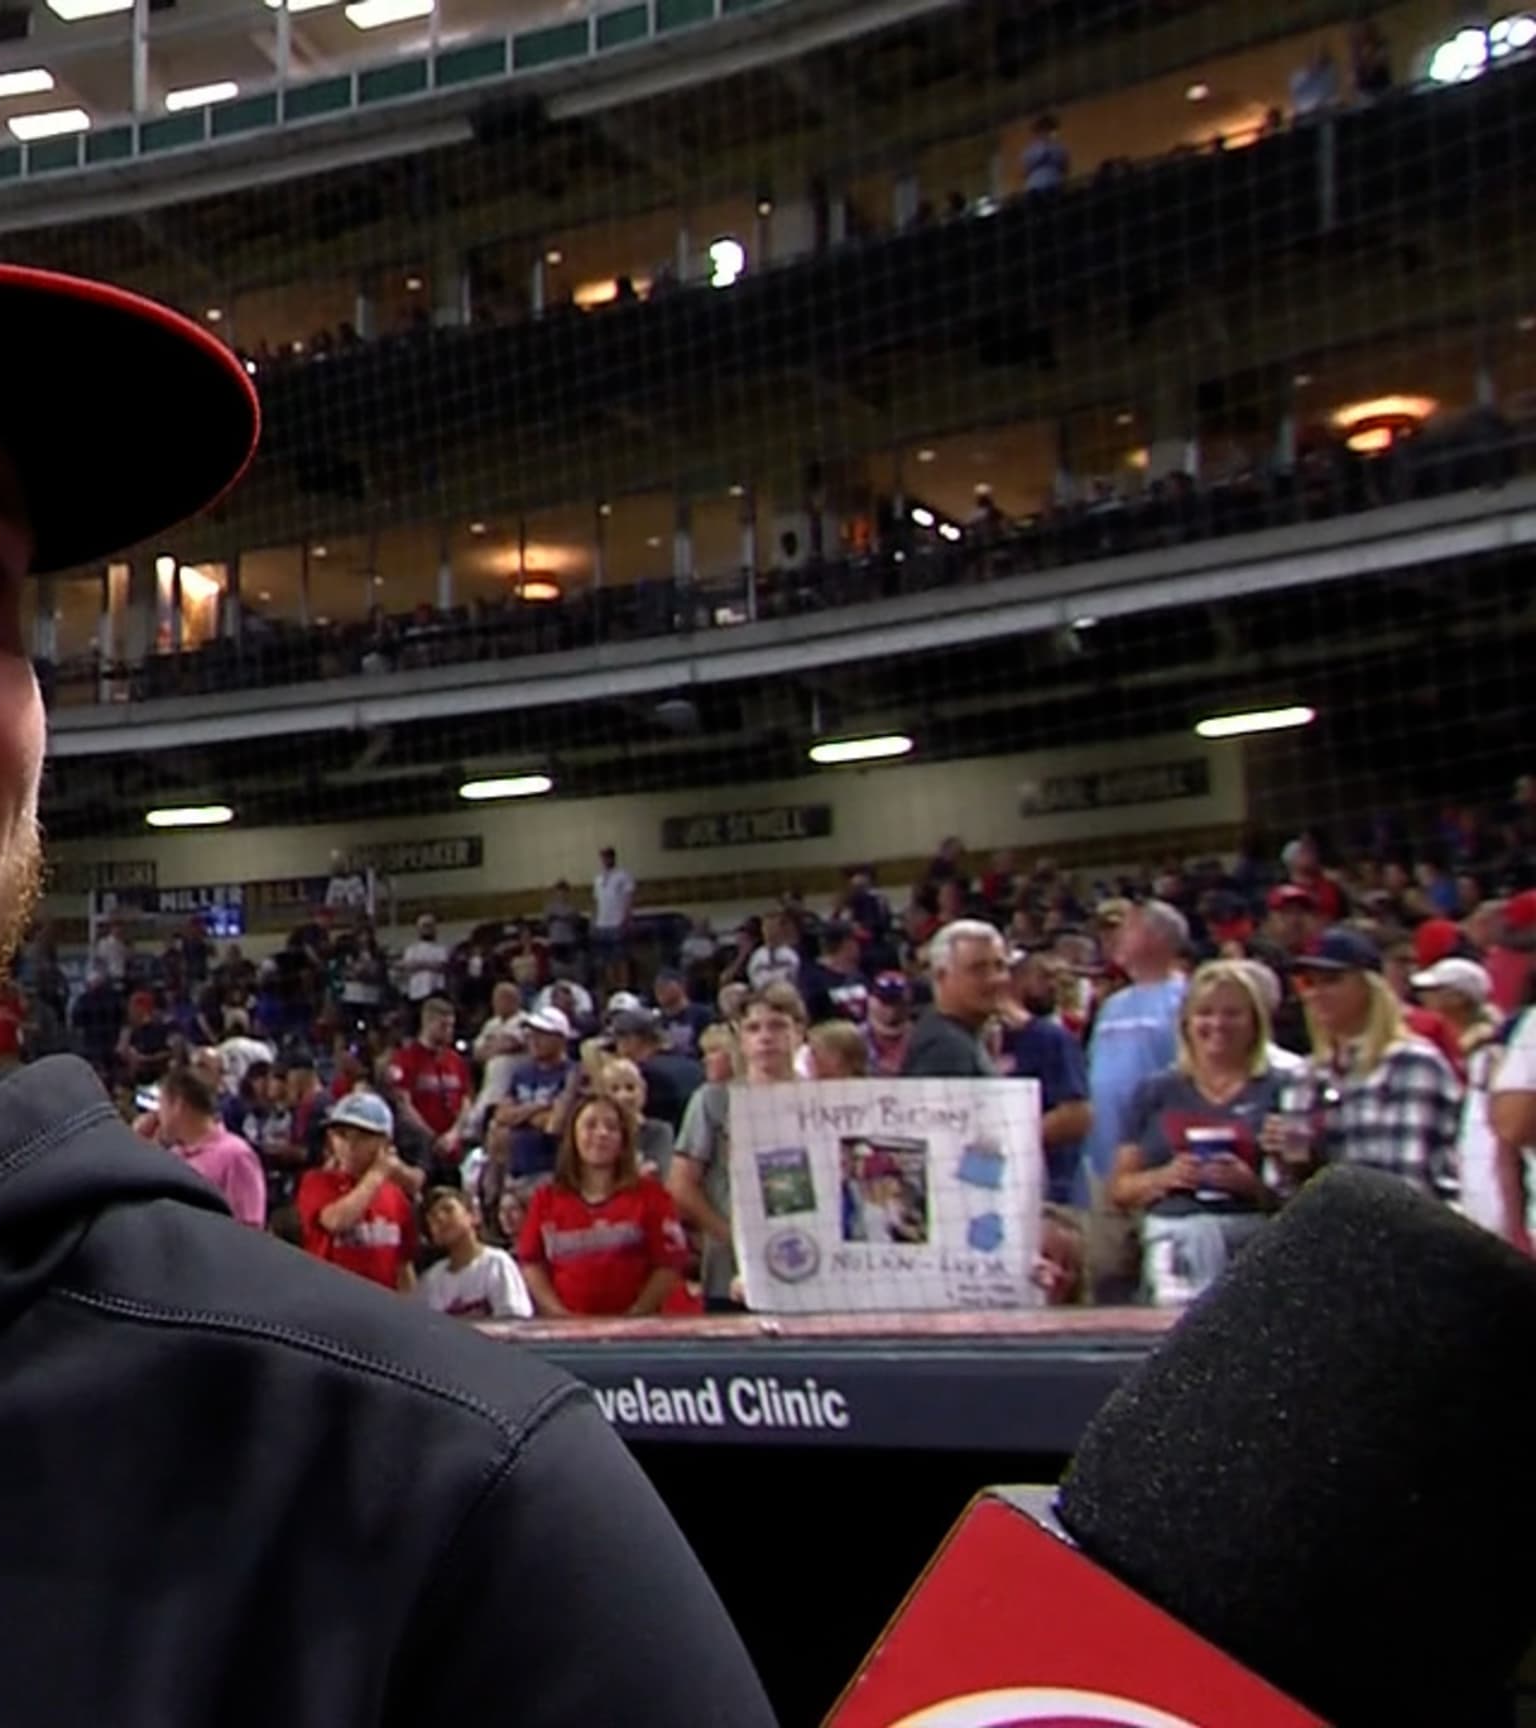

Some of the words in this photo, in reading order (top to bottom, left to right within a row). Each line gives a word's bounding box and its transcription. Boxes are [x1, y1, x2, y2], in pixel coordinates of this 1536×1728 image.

[159, 884, 243, 912] MILLER
[593, 1377, 725, 1427] veland
[728, 1377, 850, 1428] Clinic
